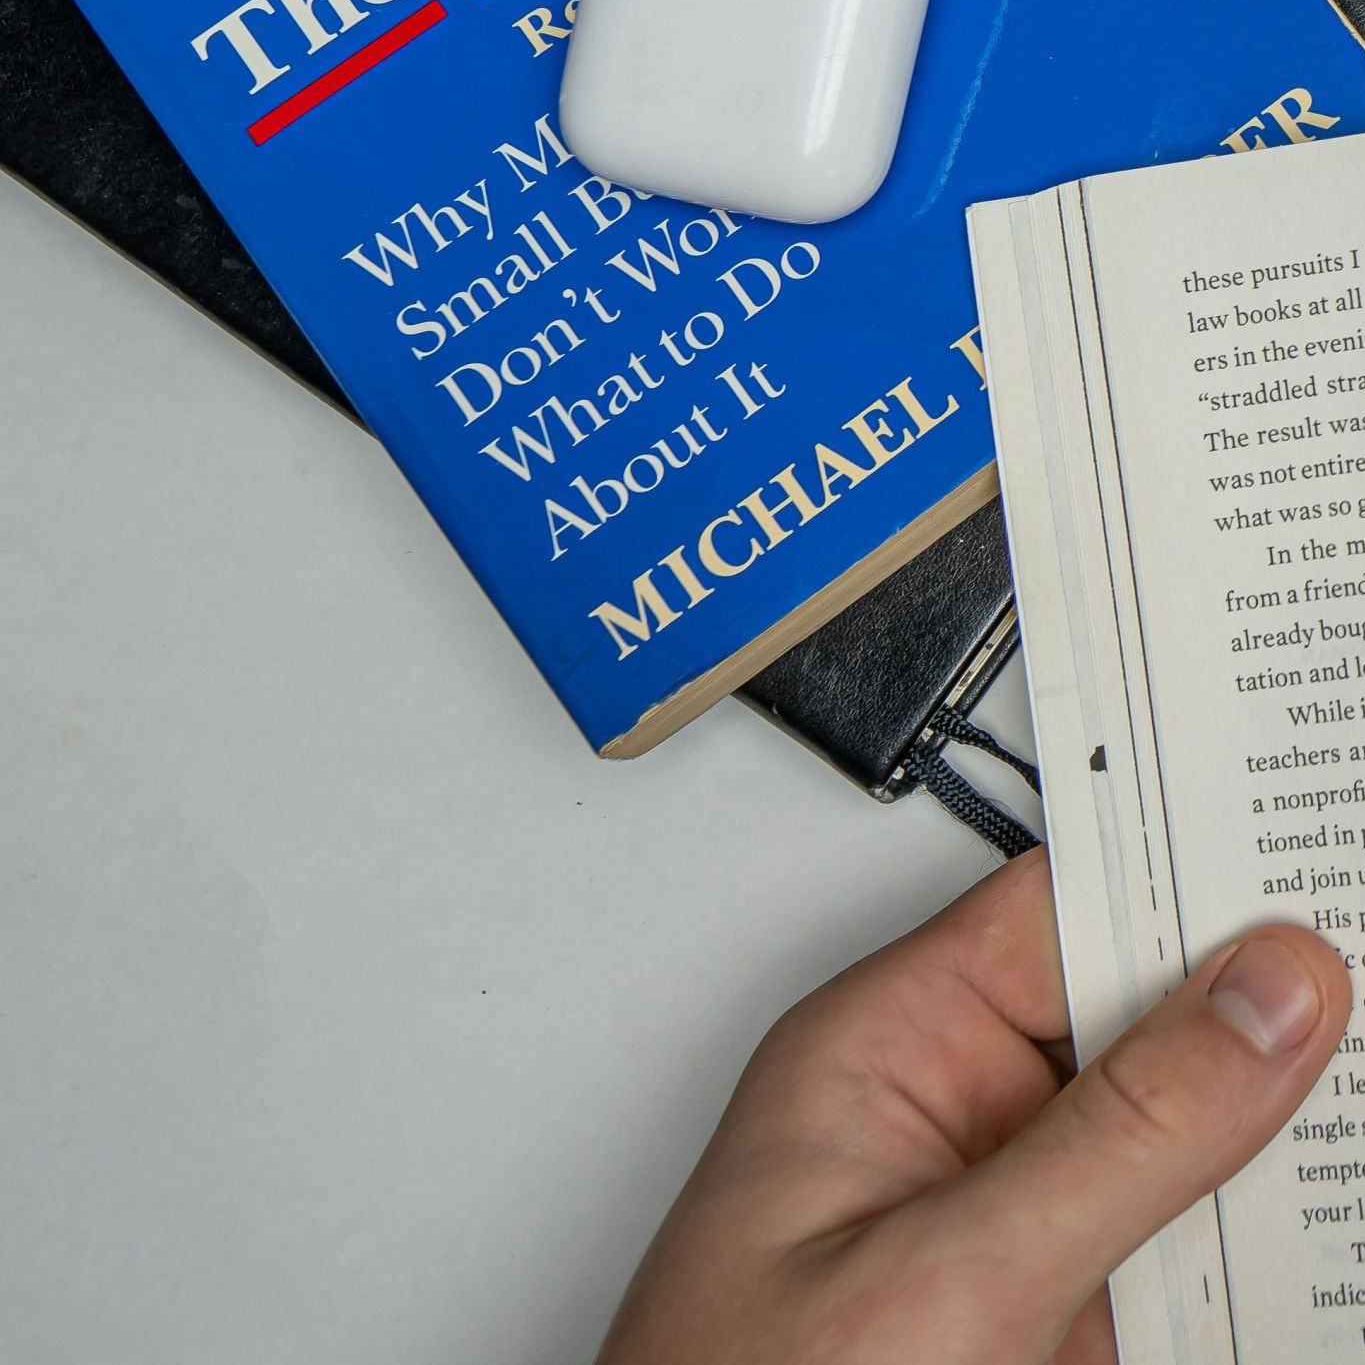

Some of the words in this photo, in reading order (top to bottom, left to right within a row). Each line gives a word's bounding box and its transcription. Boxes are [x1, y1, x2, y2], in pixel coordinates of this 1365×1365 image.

[342, 178, 493, 288] Why
[395, 211, 577, 361] Small
[1182, 271, 1244, 293] these
[1250, 253, 1344, 289] pursuits
[1349, 249, 1360, 269] I
[435, 287, 621, 428] Don’t
[605, 207, 755, 293] Wor
[479, 354, 664, 481] What
[660, 313, 723, 365] to
[716, 243, 820, 320] Do
[546, 406, 727, 560] About
[716, 363, 785, 419] It
[589, 377, 959, 660] MICHAEL
[1214, 507, 1273, 531] what
[1277, 504, 1322, 522] was
[1328, 500, 1351, 517] so
[1263, 868, 1305, 895] and
[1310, 866, 1352, 895] join
[1302, 1206, 1352, 1230] your
